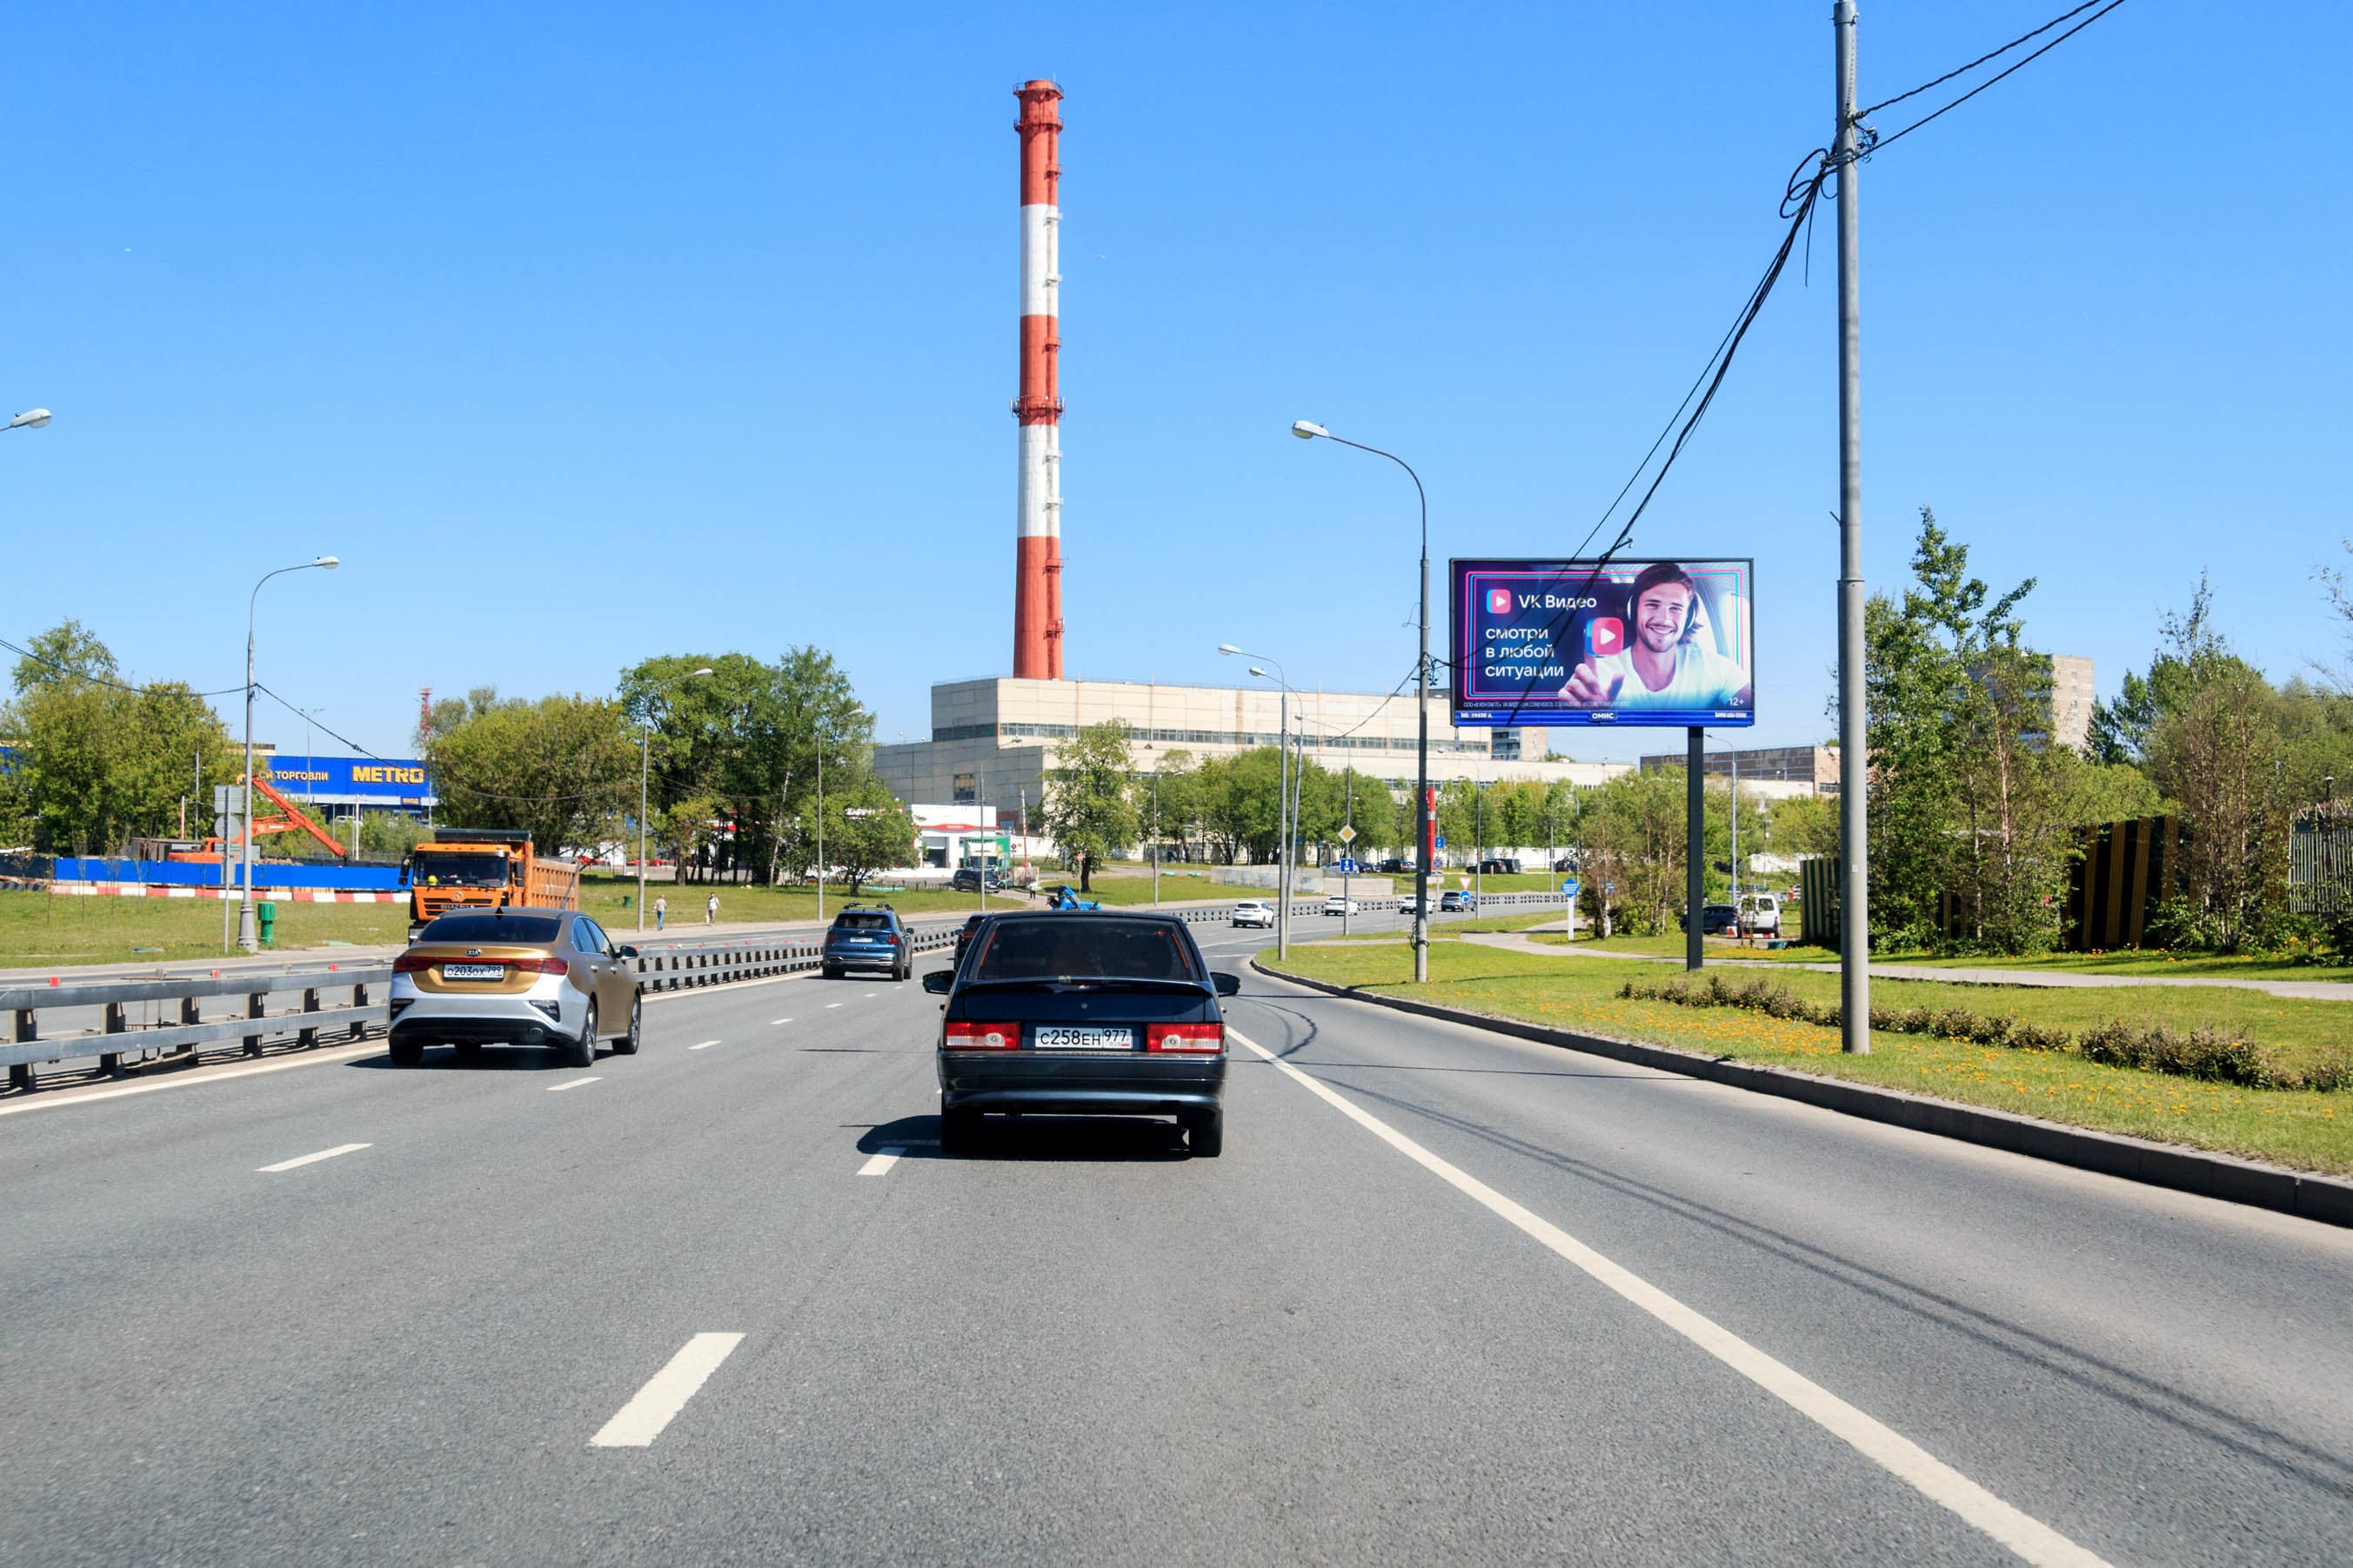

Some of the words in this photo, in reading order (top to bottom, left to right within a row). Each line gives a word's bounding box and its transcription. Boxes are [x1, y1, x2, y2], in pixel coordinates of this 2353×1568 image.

[1518, 595, 1542, 608] VK
[1545, 595, 1597, 611] Видео
[1485, 628, 1548, 642] смотри
[1485, 647, 1495, 658] в
[1499, 644, 1554, 658] любой
[1485, 666, 1564, 680] ситуации
[1728, 697, 1745, 706] 12+
[276, 771, 329, 781] ТОРГОВЛИ
[352, 765, 424, 784] METRO
